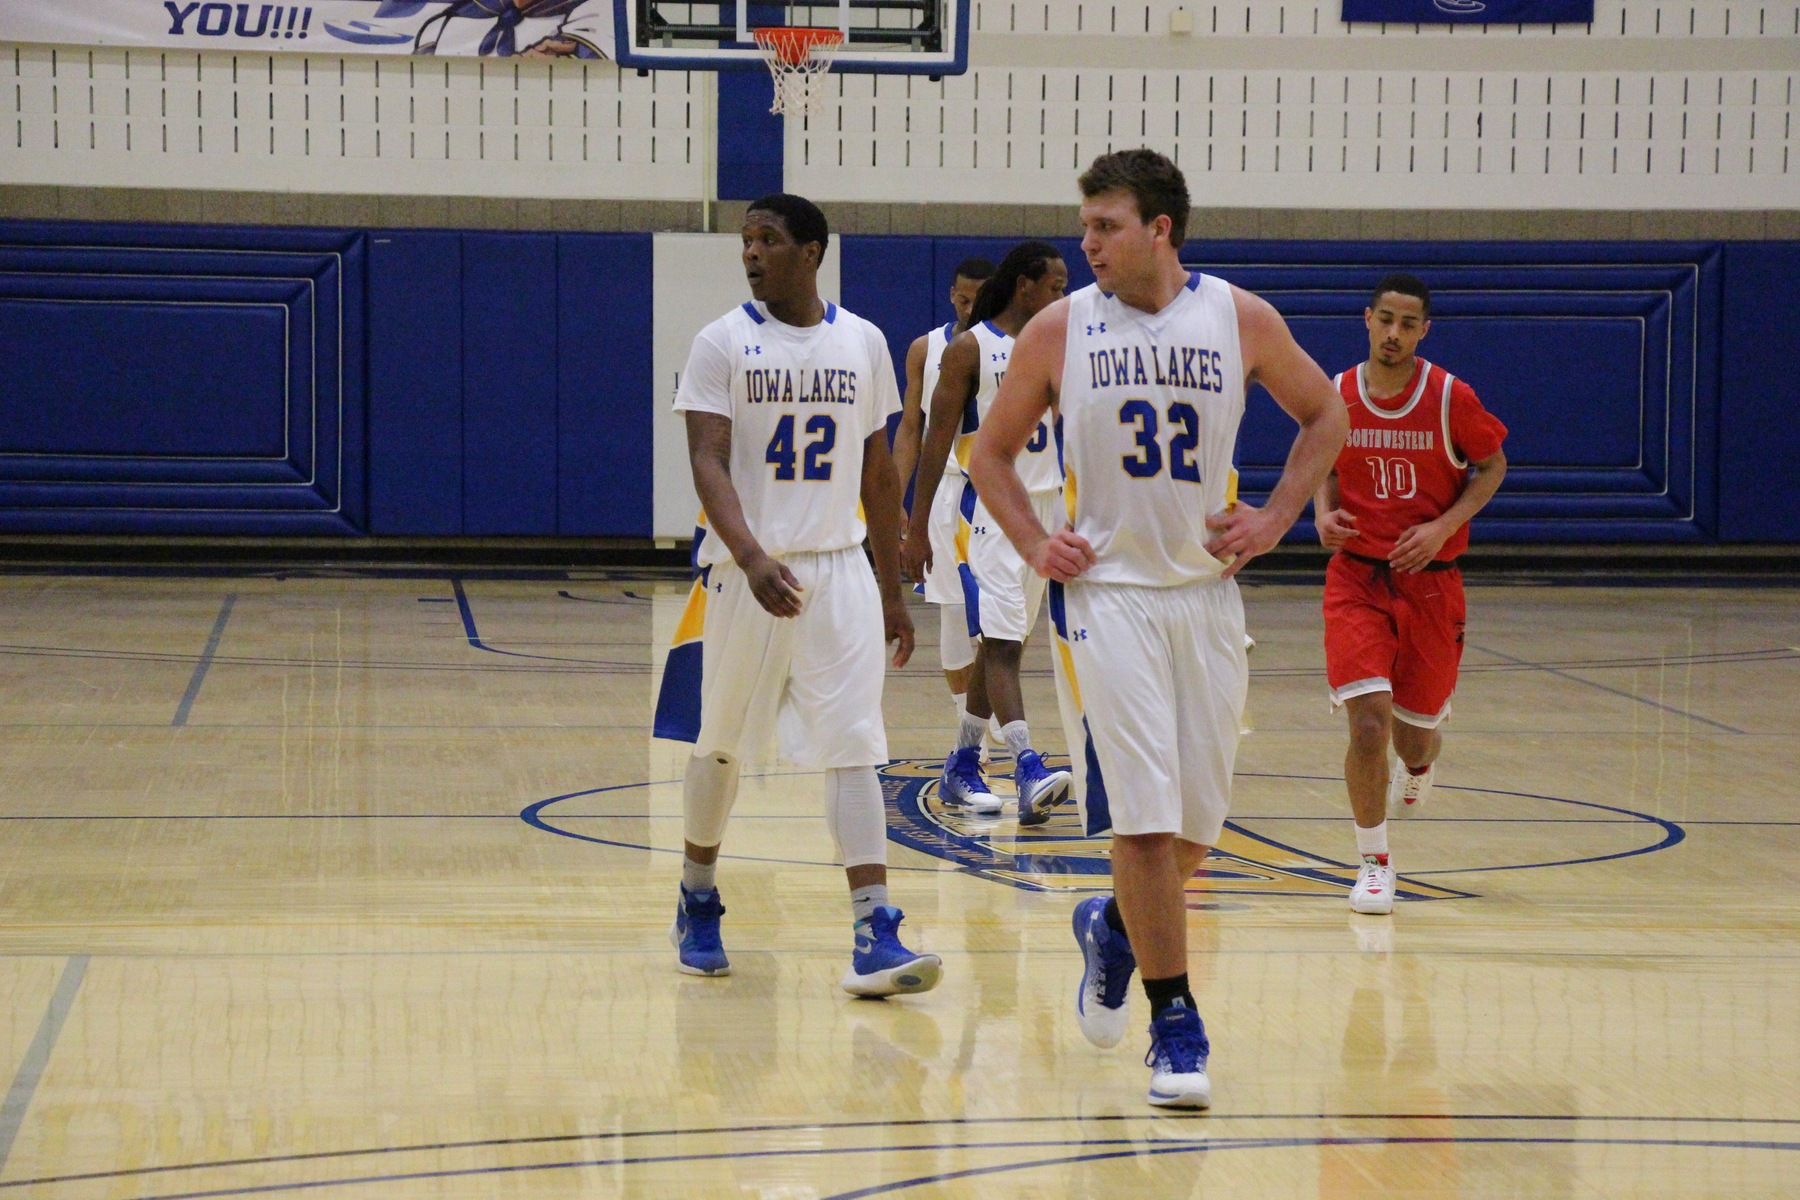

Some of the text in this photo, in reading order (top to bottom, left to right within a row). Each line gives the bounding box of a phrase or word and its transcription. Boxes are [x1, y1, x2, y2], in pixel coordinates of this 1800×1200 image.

[164, 1, 312, 39] YOU!!!
[745, 368, 857, 405] IOWA LAKES
[1089, 345, 1223, 394] IOWA LAKES
[764, 413, 837, 482] 42
[1118, 398, 1202, 485] 32
[1346, 428, 1434, 450] SOUTHWESTERN
[1365, 456, 1417, 499] 10
